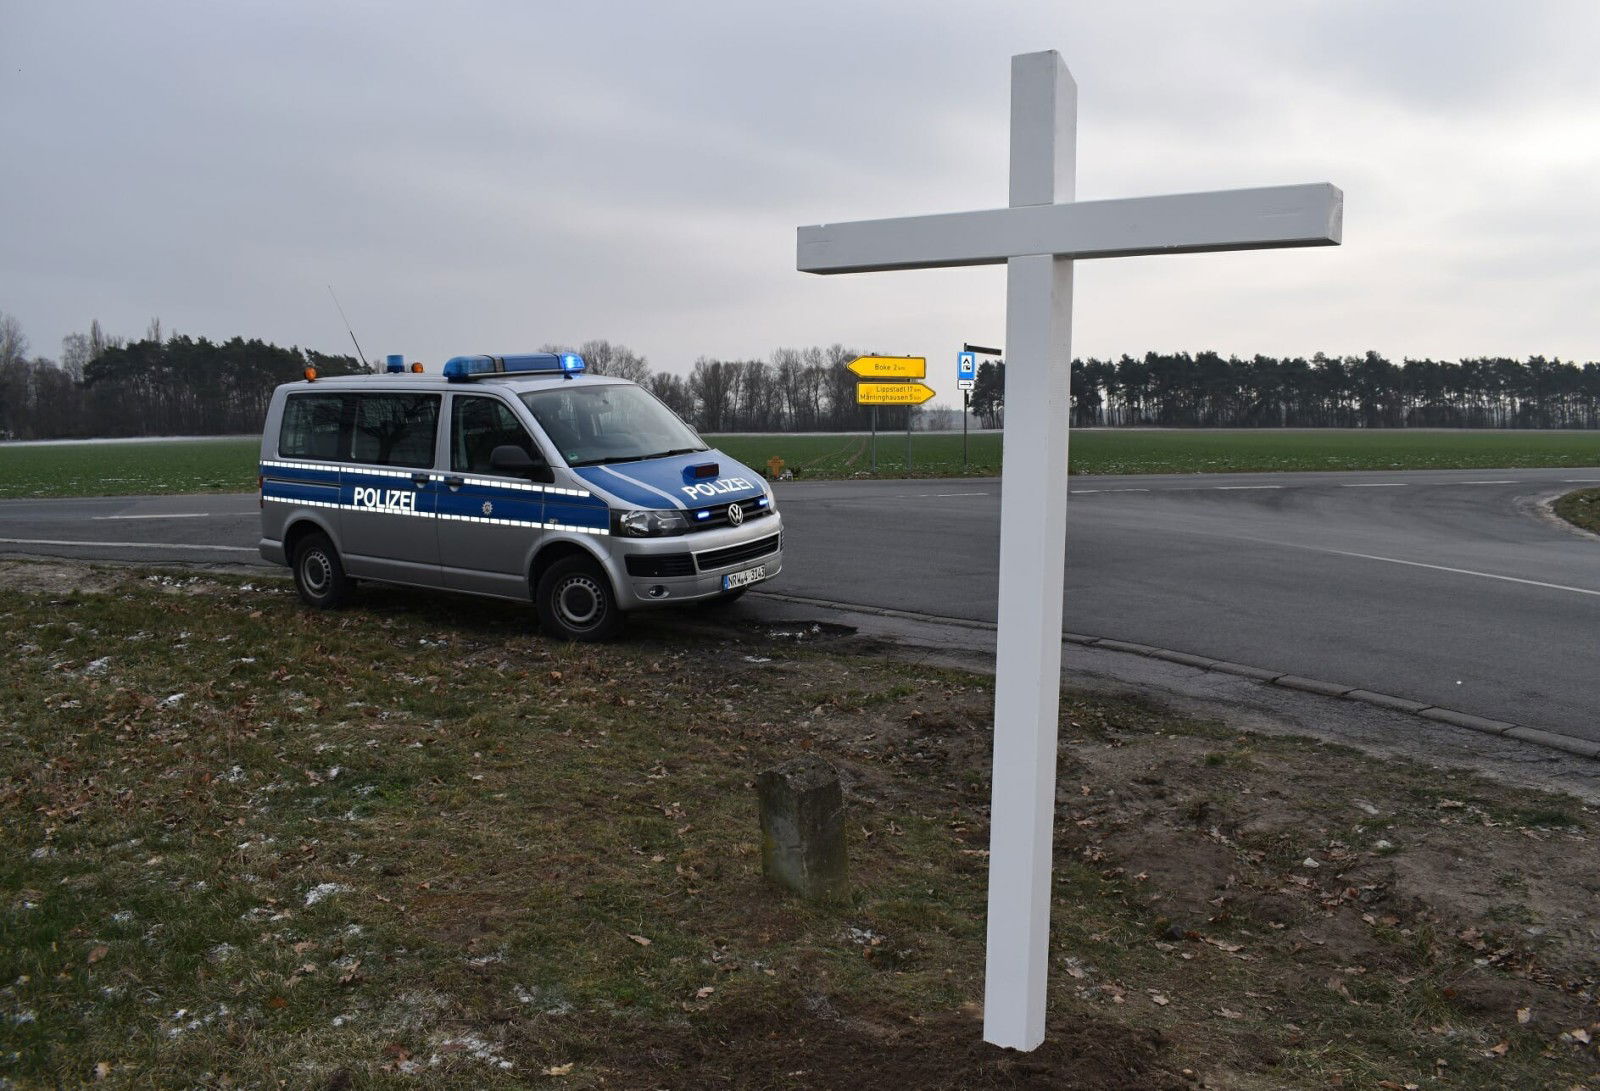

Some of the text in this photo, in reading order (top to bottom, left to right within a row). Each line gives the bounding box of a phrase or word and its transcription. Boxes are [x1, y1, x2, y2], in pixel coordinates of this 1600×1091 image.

[874, 363, 891, 371] Boke
[353, 486, 416, 511] POLIZEI
[681, 477, 754, 500] POLIZEI
